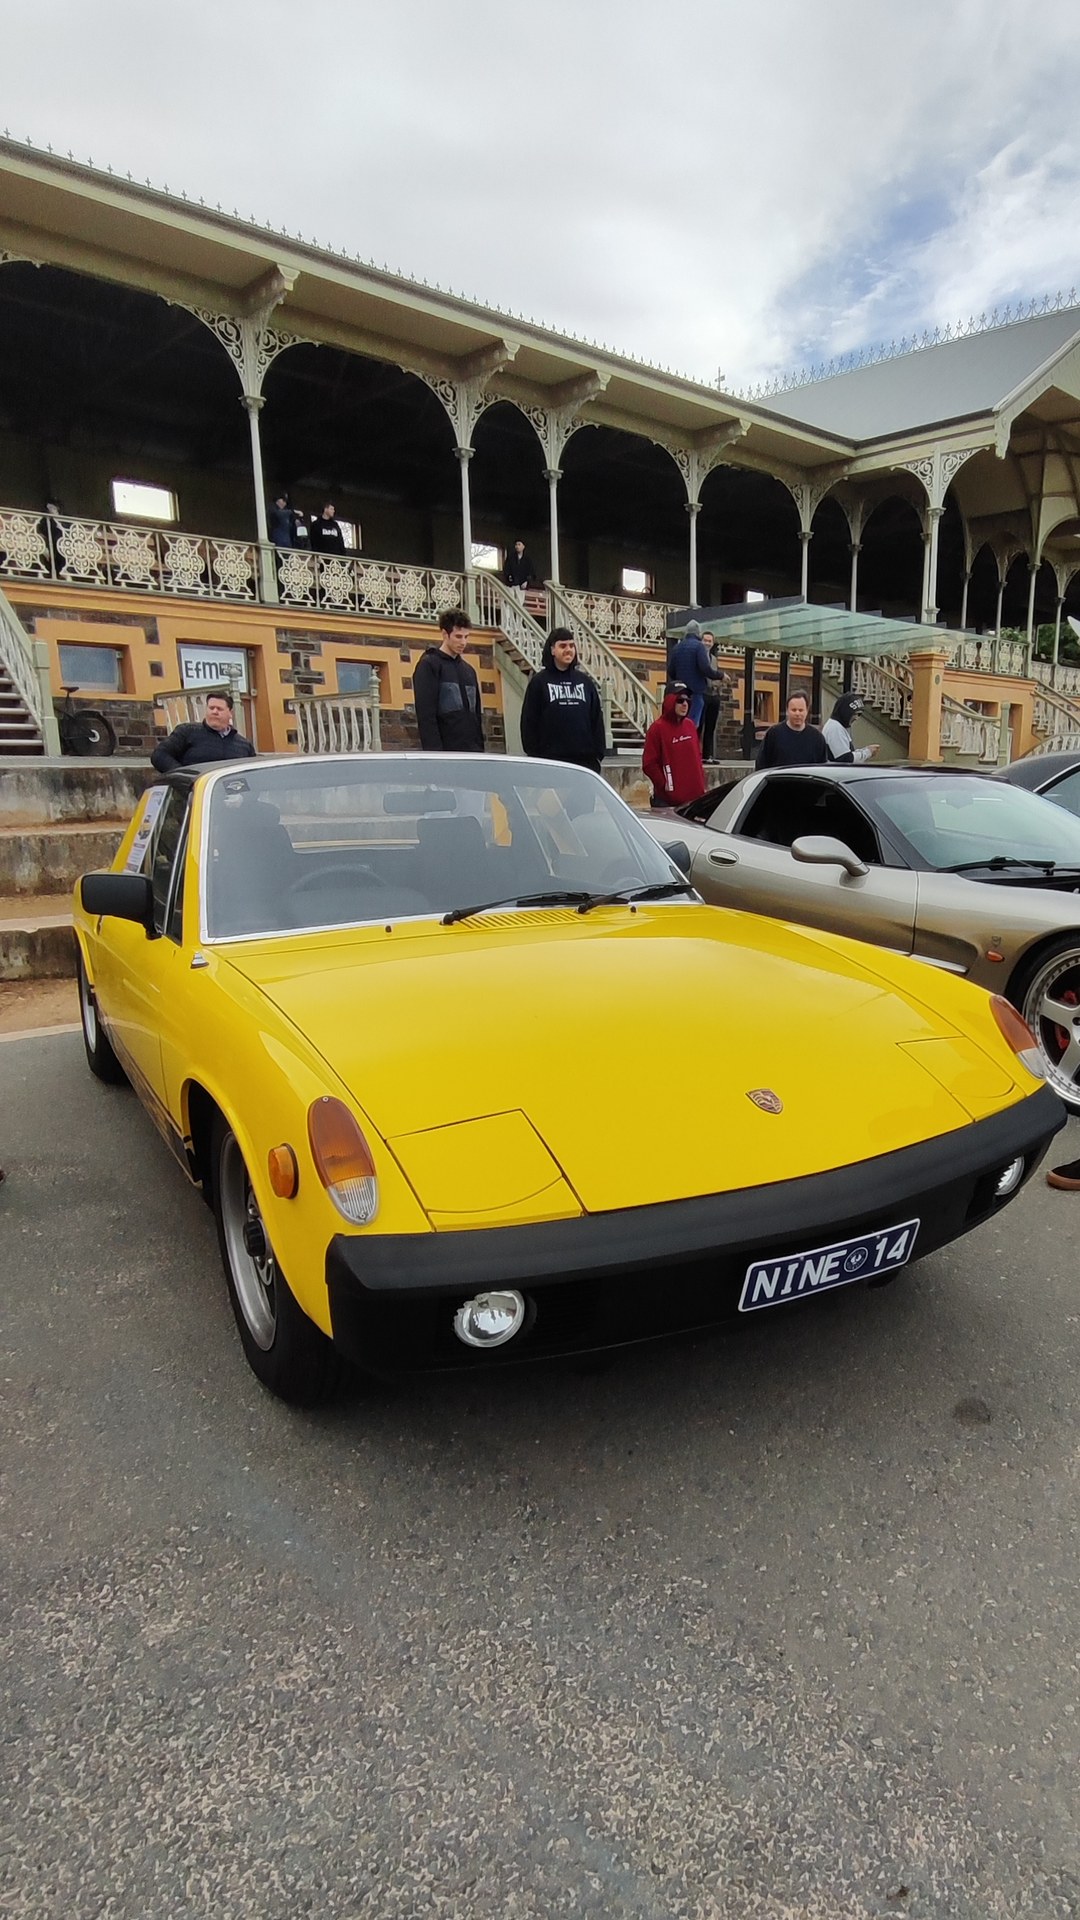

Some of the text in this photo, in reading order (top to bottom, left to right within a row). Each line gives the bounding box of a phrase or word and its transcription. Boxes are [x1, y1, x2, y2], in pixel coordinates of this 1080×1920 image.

[547, 682, 587, 703] EVERLAST
[752, 1230, 910, 1302] NINE 14
